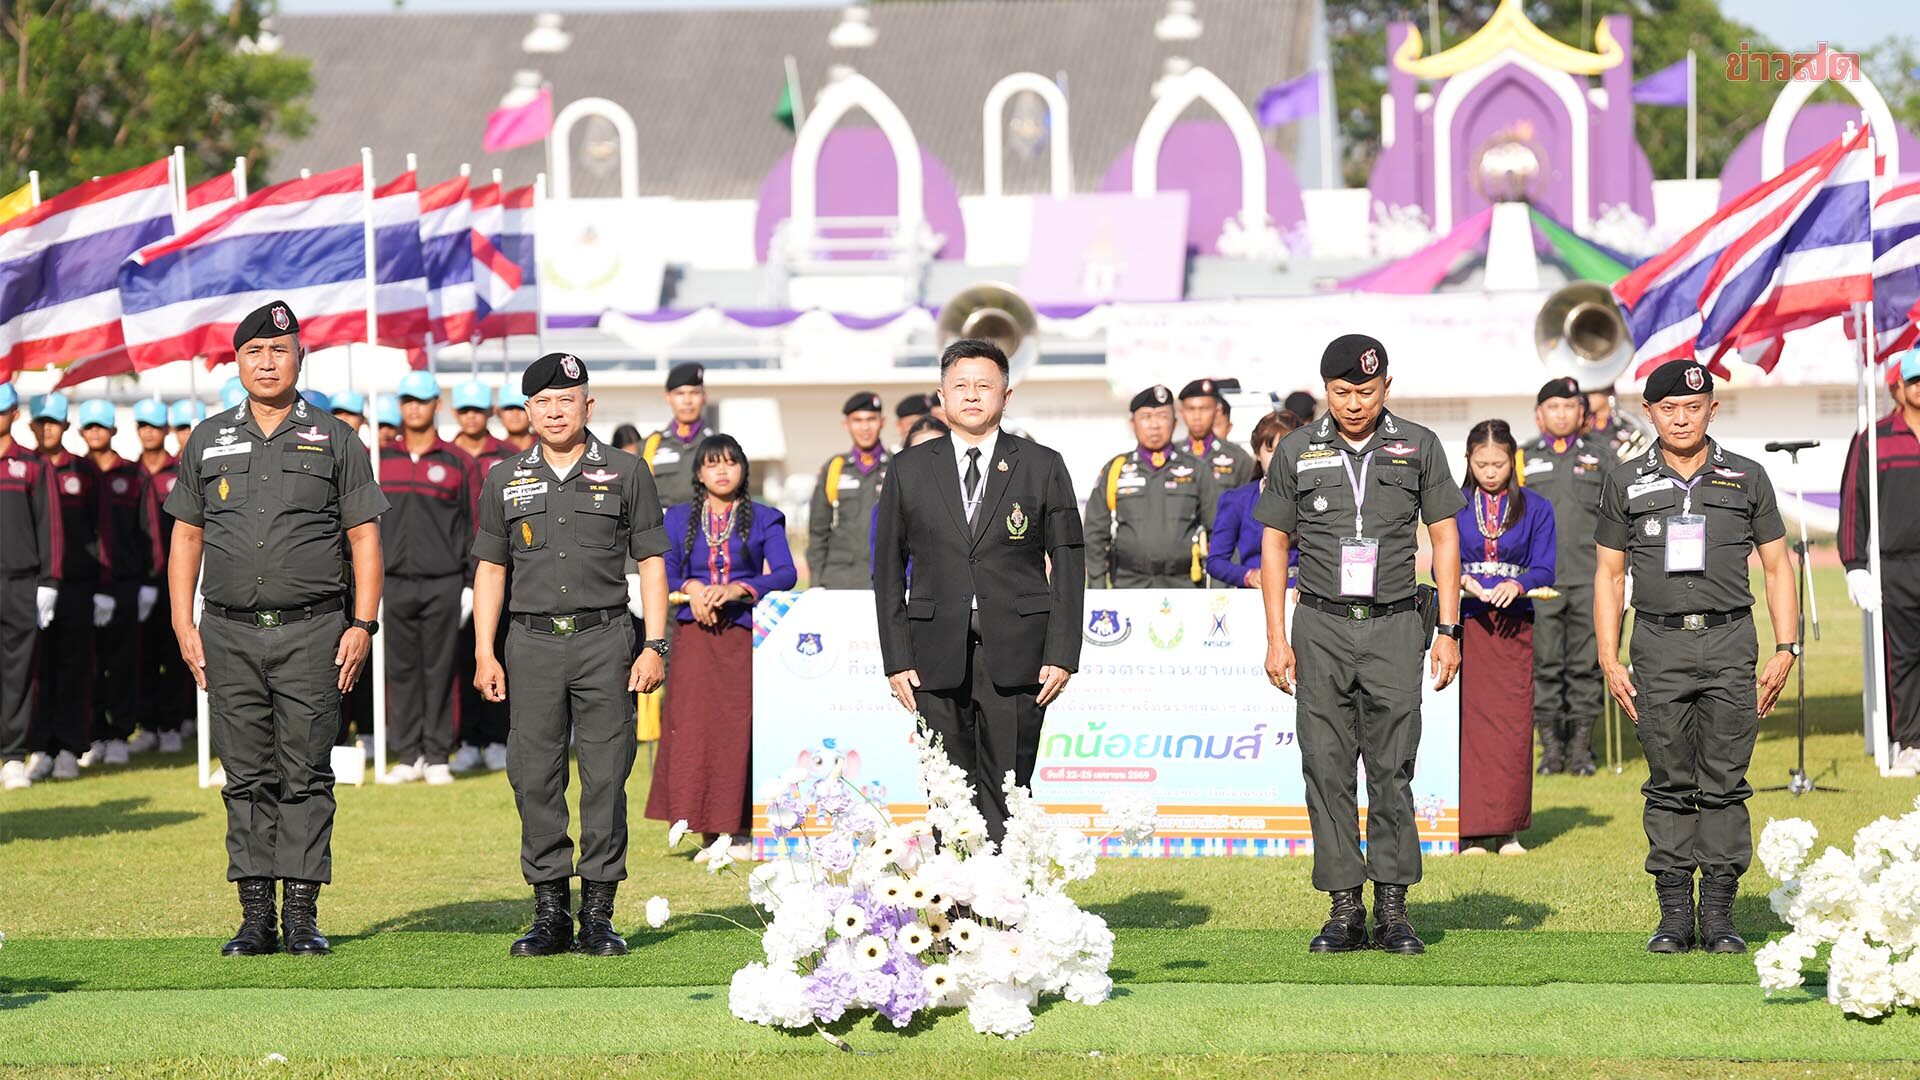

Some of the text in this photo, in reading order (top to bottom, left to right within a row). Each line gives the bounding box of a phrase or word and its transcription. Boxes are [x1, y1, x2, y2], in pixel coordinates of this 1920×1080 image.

[1083, 663, 1264, 677] รวจตระเวนชายแด
[1040, 722, 1268, 759] กน้อยเกมส์
